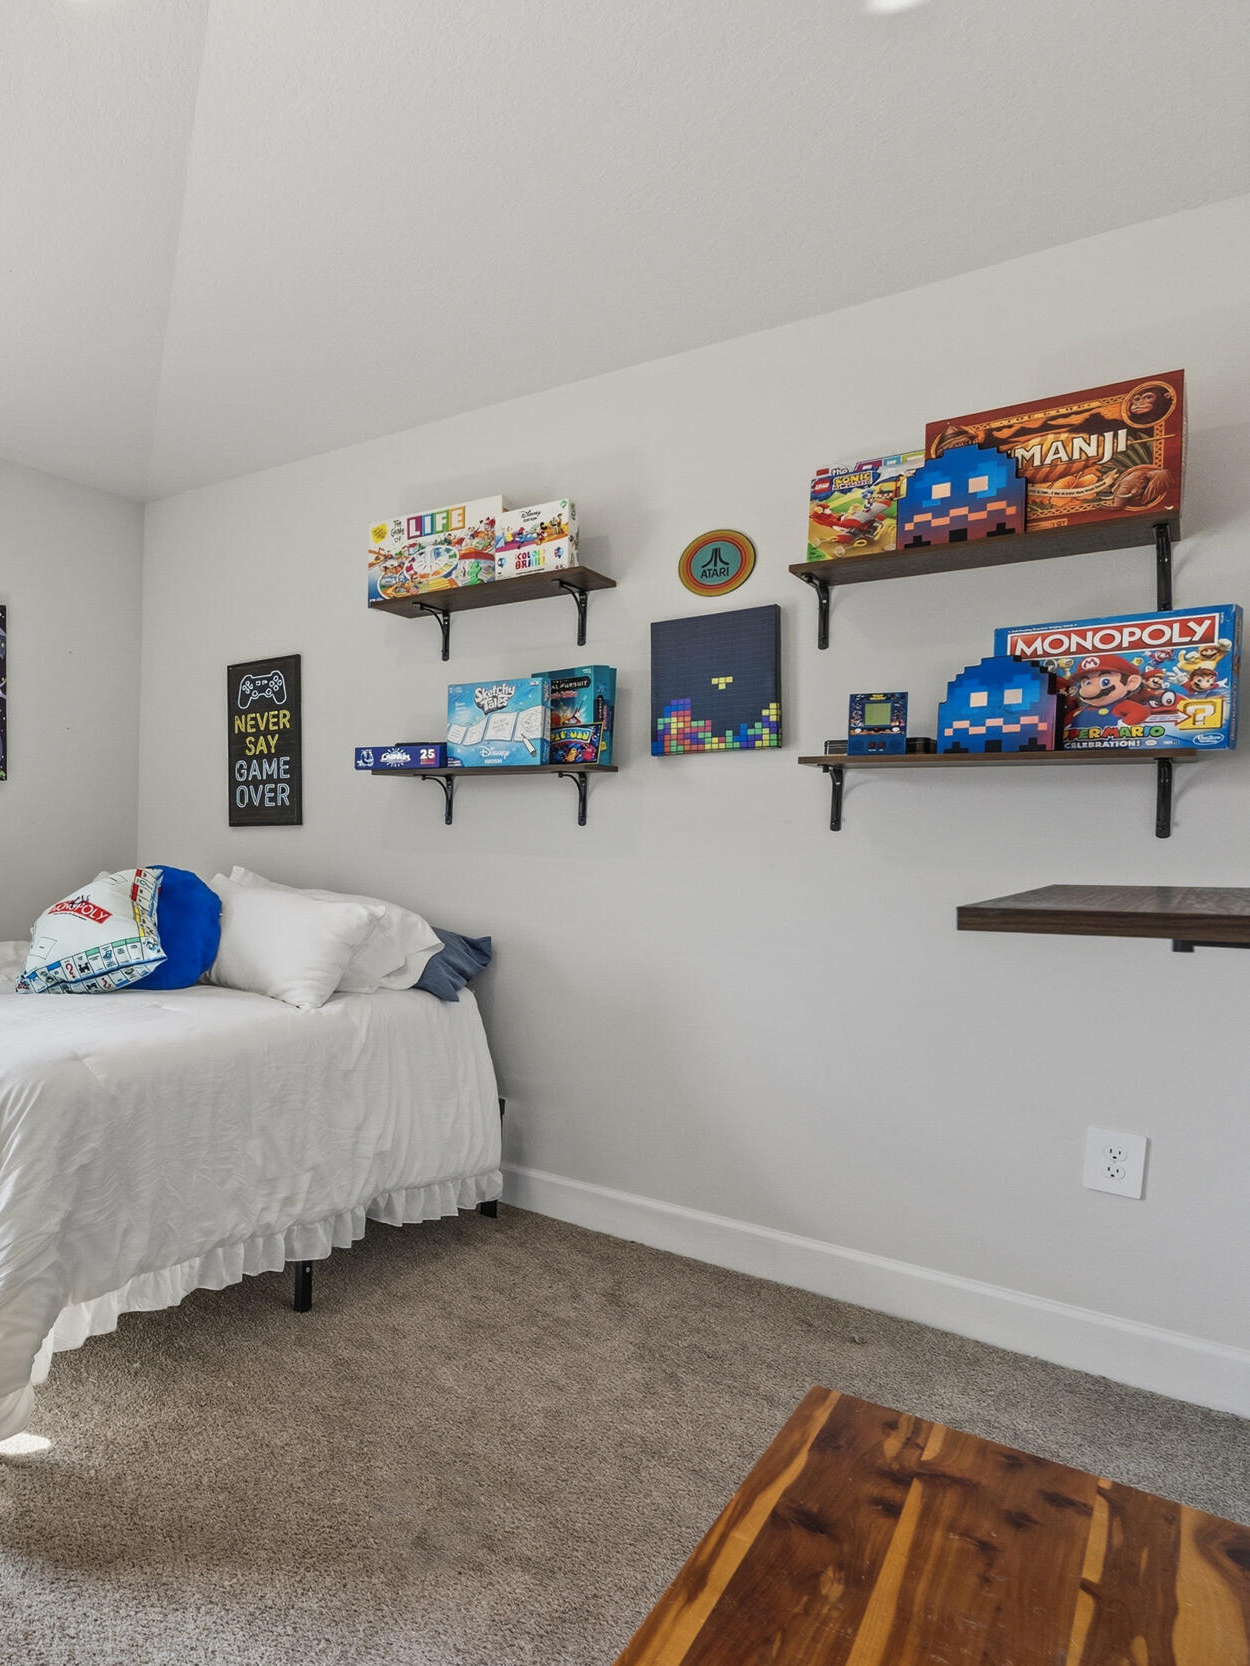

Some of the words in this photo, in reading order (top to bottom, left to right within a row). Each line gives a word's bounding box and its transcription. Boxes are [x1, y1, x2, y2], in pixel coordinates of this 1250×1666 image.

[1008, 428, 1128, 469] MANJI
[834, 472, 871, 486] SONIC
[407, 506, 465, 540] LIFE
[701, 567, 729, 578] ATARI
[1015, 619, 1211, 656] MONOPOLY
[474, 684, 515, 702] Sketchy
[234, 709, 290, 734] NEVER
[1063, 727, 1101, 740] PER
[1101, 725, 1166, 738] MARIO
[245, 733, 279, 756] SAY
[479, 745, 509, 759] Disney
[1064, 739, 1140, 749] CELEBRATION!
[420, 749, 436, 760] 25
[235, 756, 290, 782] GAME
[236, 783, 290, 808] OVER
